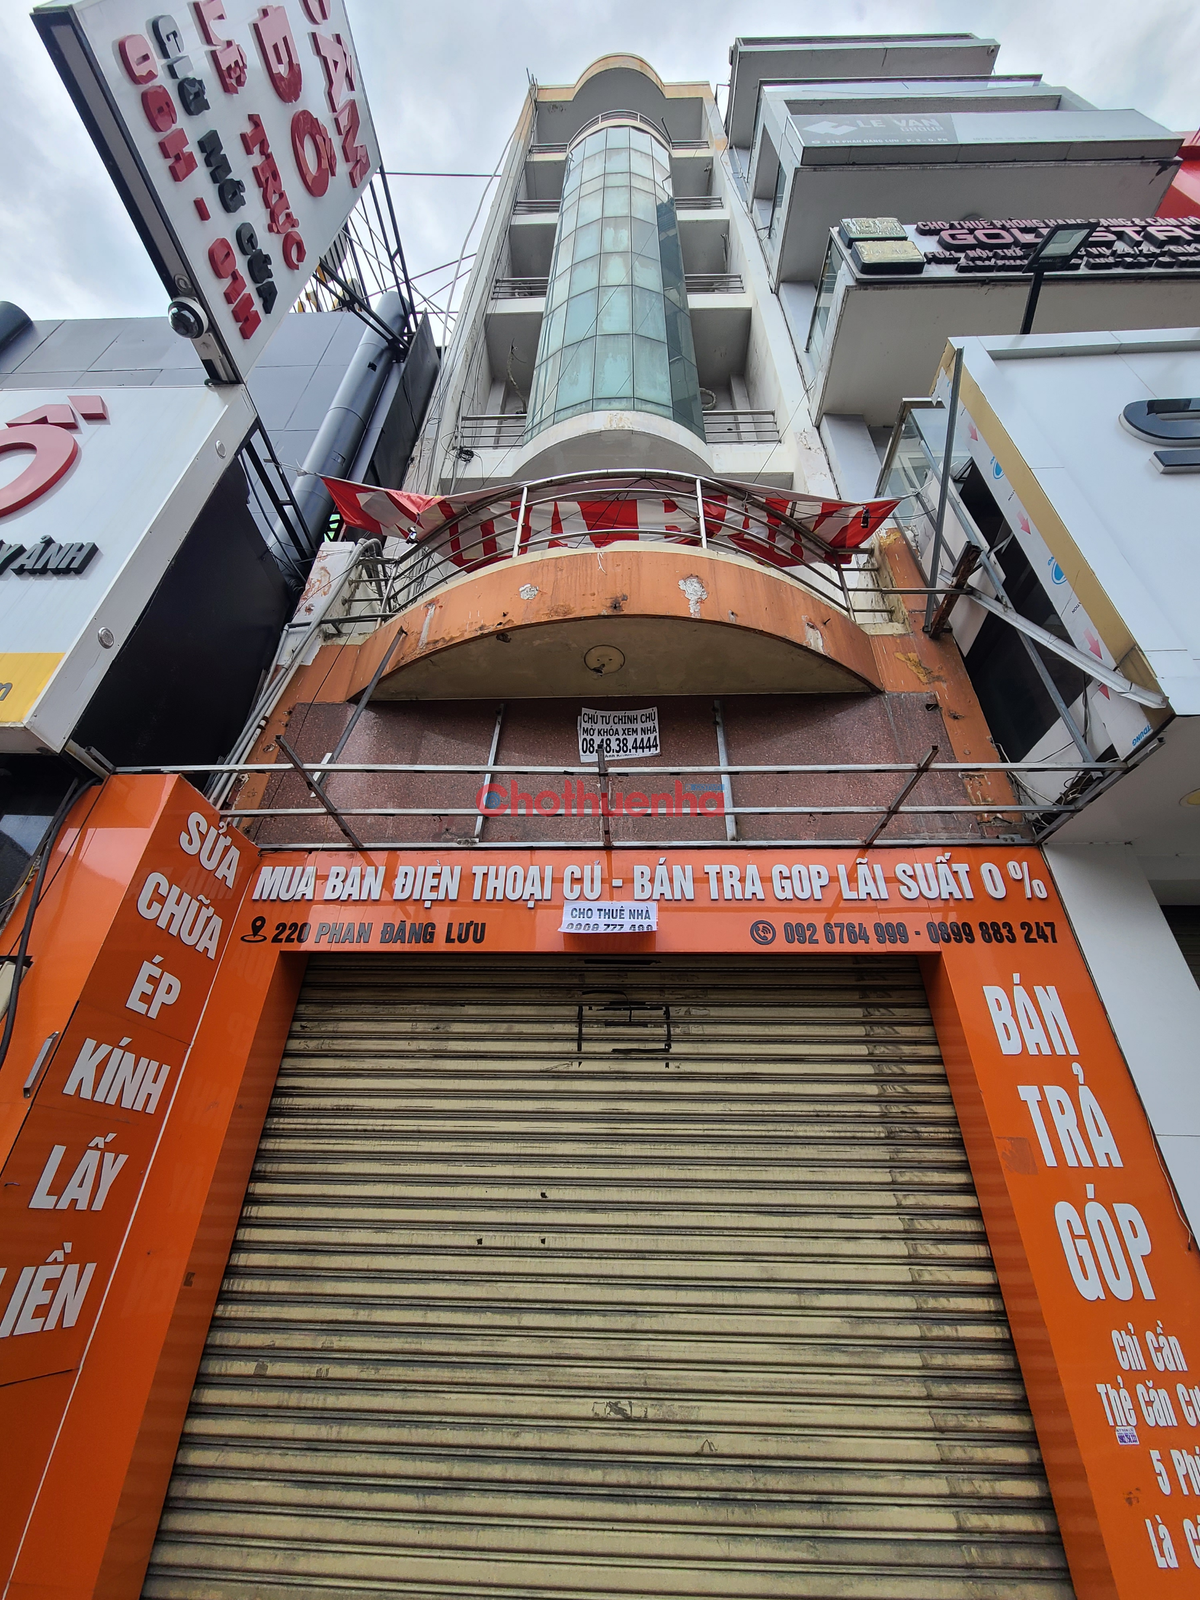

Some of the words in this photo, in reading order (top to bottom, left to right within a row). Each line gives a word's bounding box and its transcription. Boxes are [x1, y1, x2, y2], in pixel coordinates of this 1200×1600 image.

[916, 221, 950, 231] CHO
[937, 228, 1050, 245] GOL
[582, 711, 599, 725] CHÚ
[612, 712, 638, 725] CHÍNH
[640, 709, 656, 724] CHỦ
[582, 725, 596, 737] MỞ
[597, 726, 620, 737] KHÓA
[621, 727, 639, 736] XEM
[640, 722, 658, 736] NHÀ
[179, 810, 241, 891] SỬA
[251, 865, 317, 901] MUA
[471, 865, 554, 909] THOẠI
[612, 878, 623, 888] -
[632, 857, 696, 901] BÁN
[836, 858, 890, 901] LÃI
[897, 852, 973, 901] SUẤT
[1008, 860, 1049, 900] %
[136, 870, 223, 961] CHỮA
[270, 921, 310, 944] 220
[314, 922, 374, 944] PHAN
[380, 919, 437, 944] ĐĂNG
[445, 921, 487, 944] LƯU
[783, 921, 819, 944] 092
[823, 922, 870, 944] 6764
[874, 922, 909, 944] 999
[928, 921, 975, 944] 0899
[979, 921, 1018, 943] 883
[1023, 921, 1058, 944] 247
[570, 907, 594, 919] CHO
[597, 905, 625, 920] THUÊ
[629, 905, 651, 920] NHÀ
[125, 956, 182, 1020] ÉP
[982, 973, 1080, 1056] BÁN
[62, 1036, 171, 1116] KÍNH
[1017, 1062, 1124, 1168] TRẢ
[28, 1133, 129, 1211] LẤY
[1054, 1183, 1156, 1301] GÓP
[0, 1242, 97, 1338] IỀN
[1149, 1449, 1172, 1496] 5
[1144, 1514, 1179, 1568] Là
[1183, 1515, 1200, 1568] C
